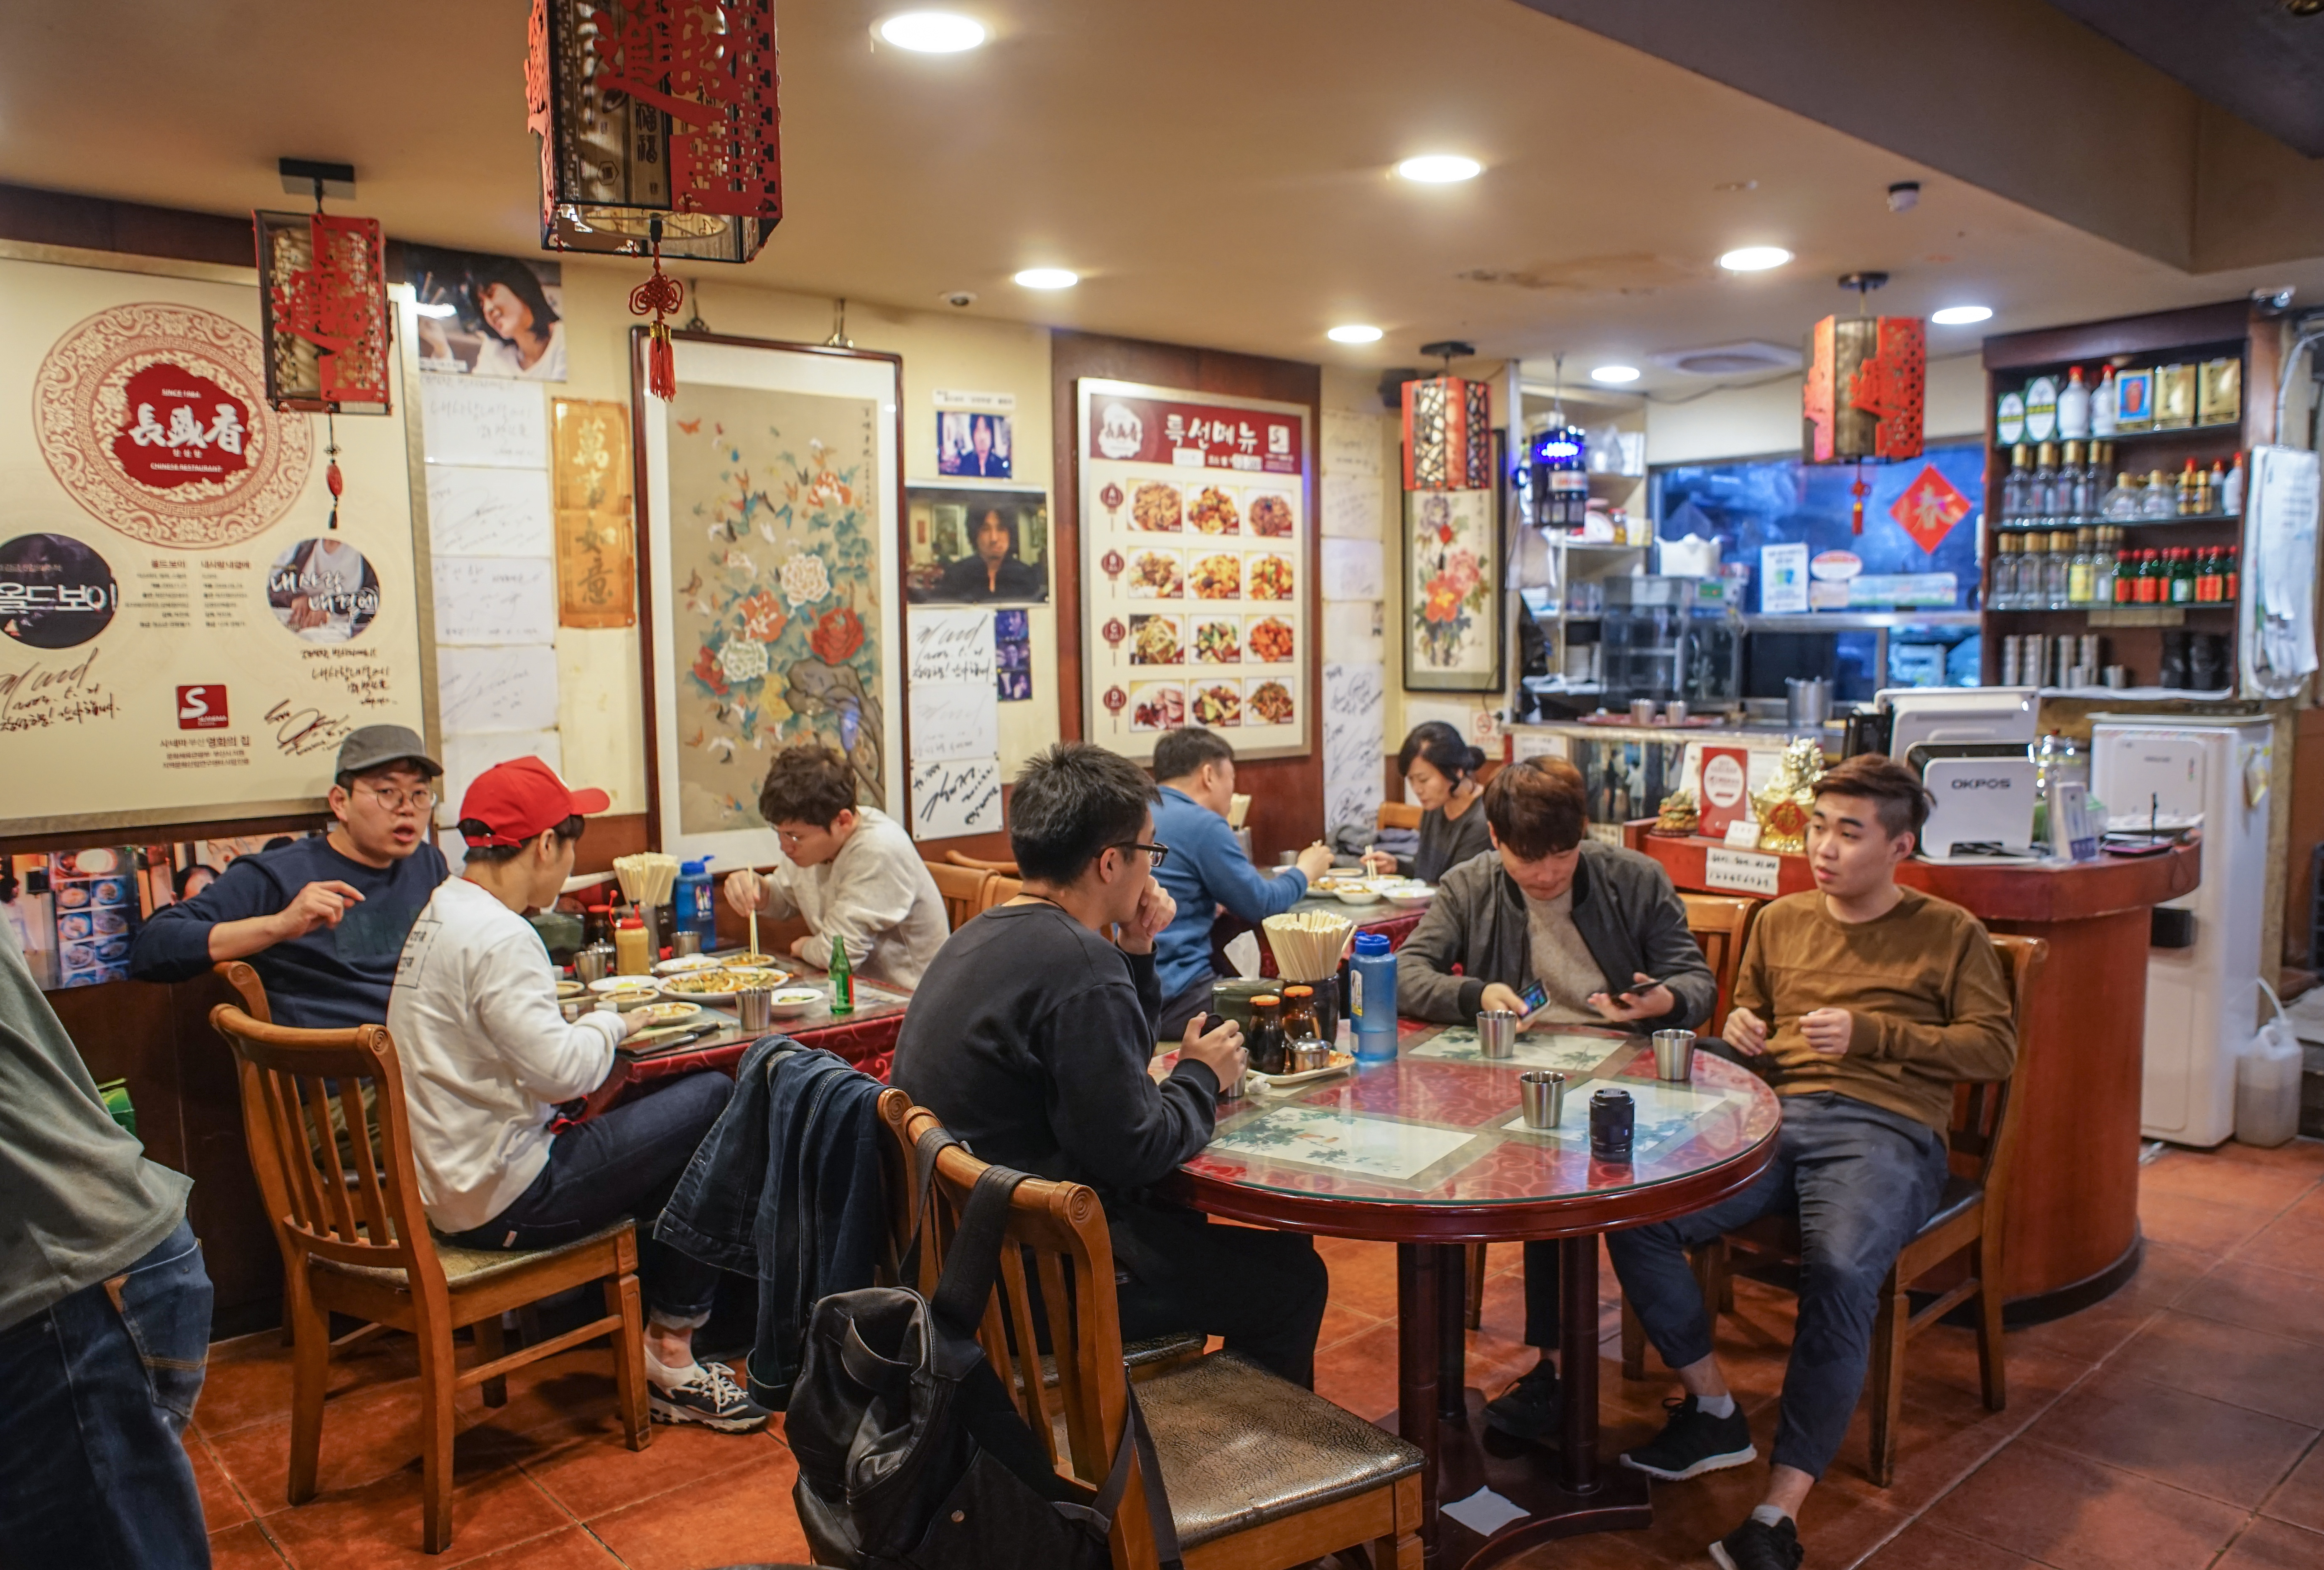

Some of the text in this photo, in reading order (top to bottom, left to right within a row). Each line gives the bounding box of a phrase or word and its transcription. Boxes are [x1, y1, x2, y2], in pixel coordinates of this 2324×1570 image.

[161, 388, 183, 397] SINCE
[128, 402, 245, 455] 長盛香
[150, 462, 224, 473] CHINESE RESTAURANT
[180, 687, 209, 719] S
[1951, 778, 2011, 790] OKPOS
